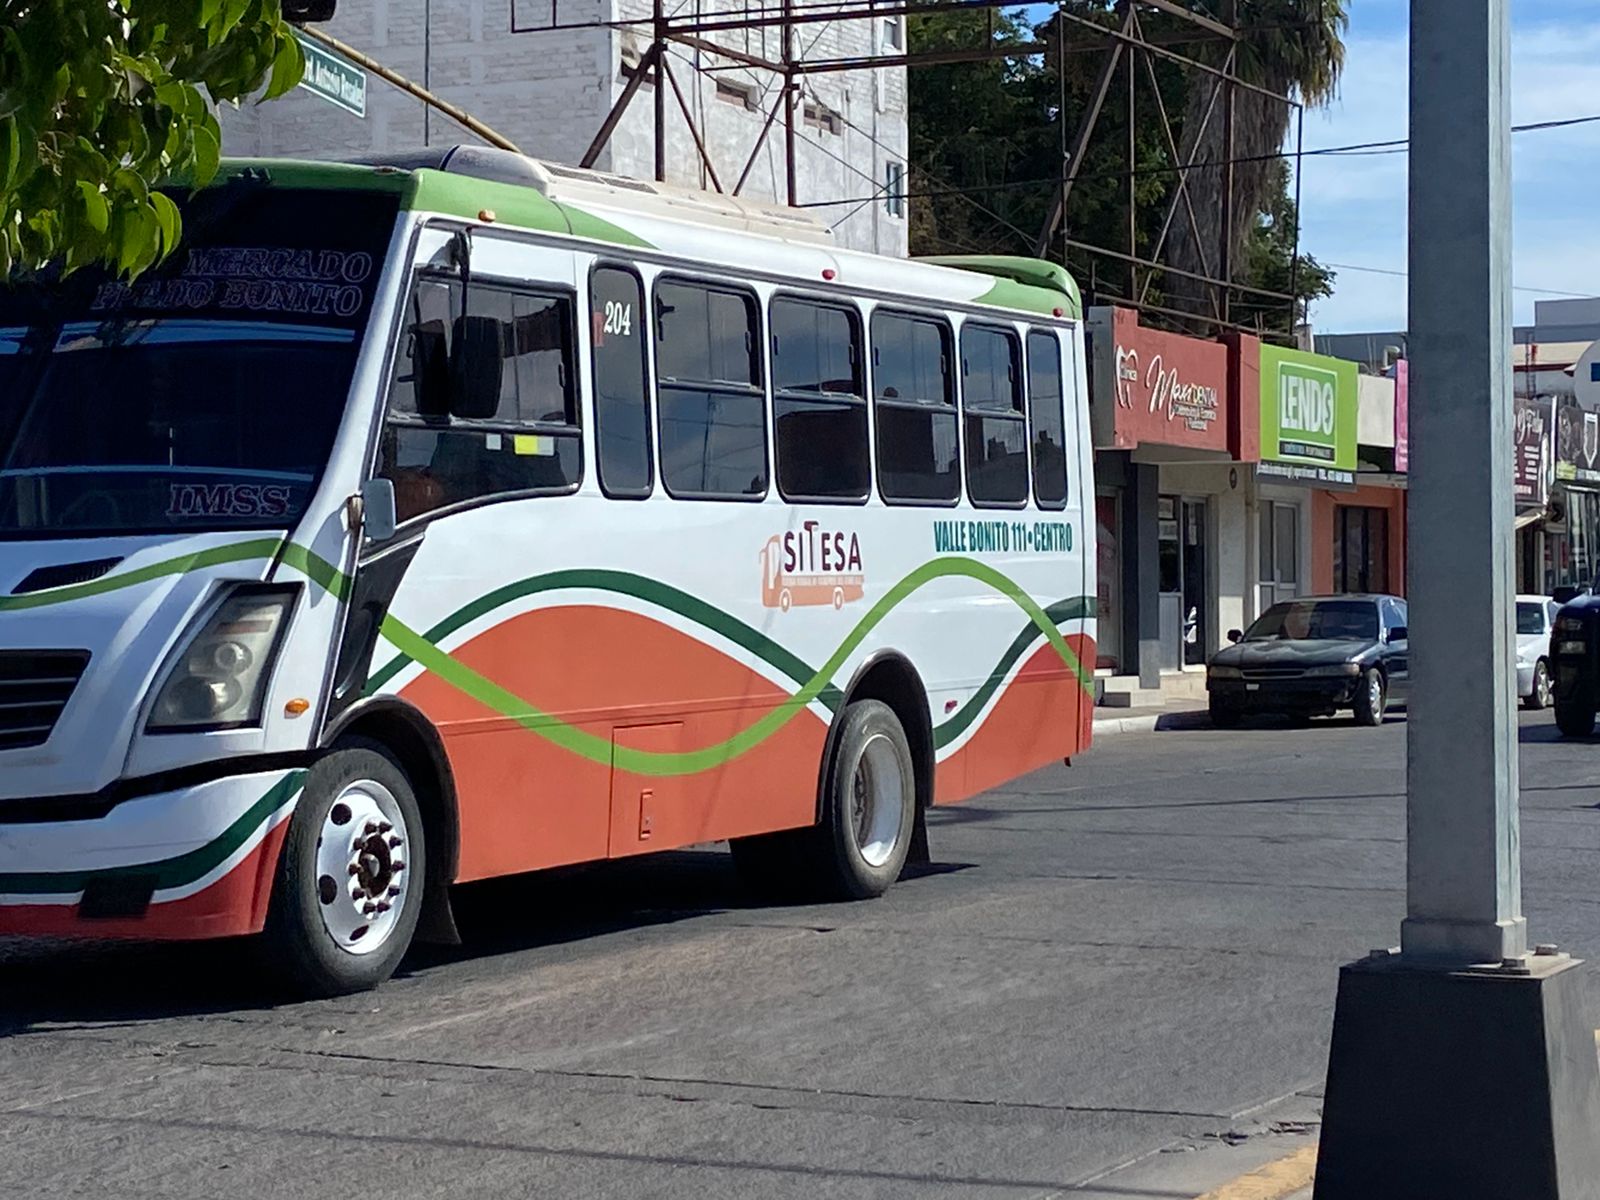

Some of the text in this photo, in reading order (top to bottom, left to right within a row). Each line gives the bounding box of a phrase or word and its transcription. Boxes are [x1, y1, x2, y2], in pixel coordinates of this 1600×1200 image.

[182, 248, 372, 283] MERCADO
[219, 279, 363, 316] BONITO
[603, 300, 631, 336] 204
[165, 484, 292, 517] IMSS
[784, 520, 863, 573] SITESA
[933, 521, 967, 553] VALLE
[969, 521, 1009, 553] BONITO
